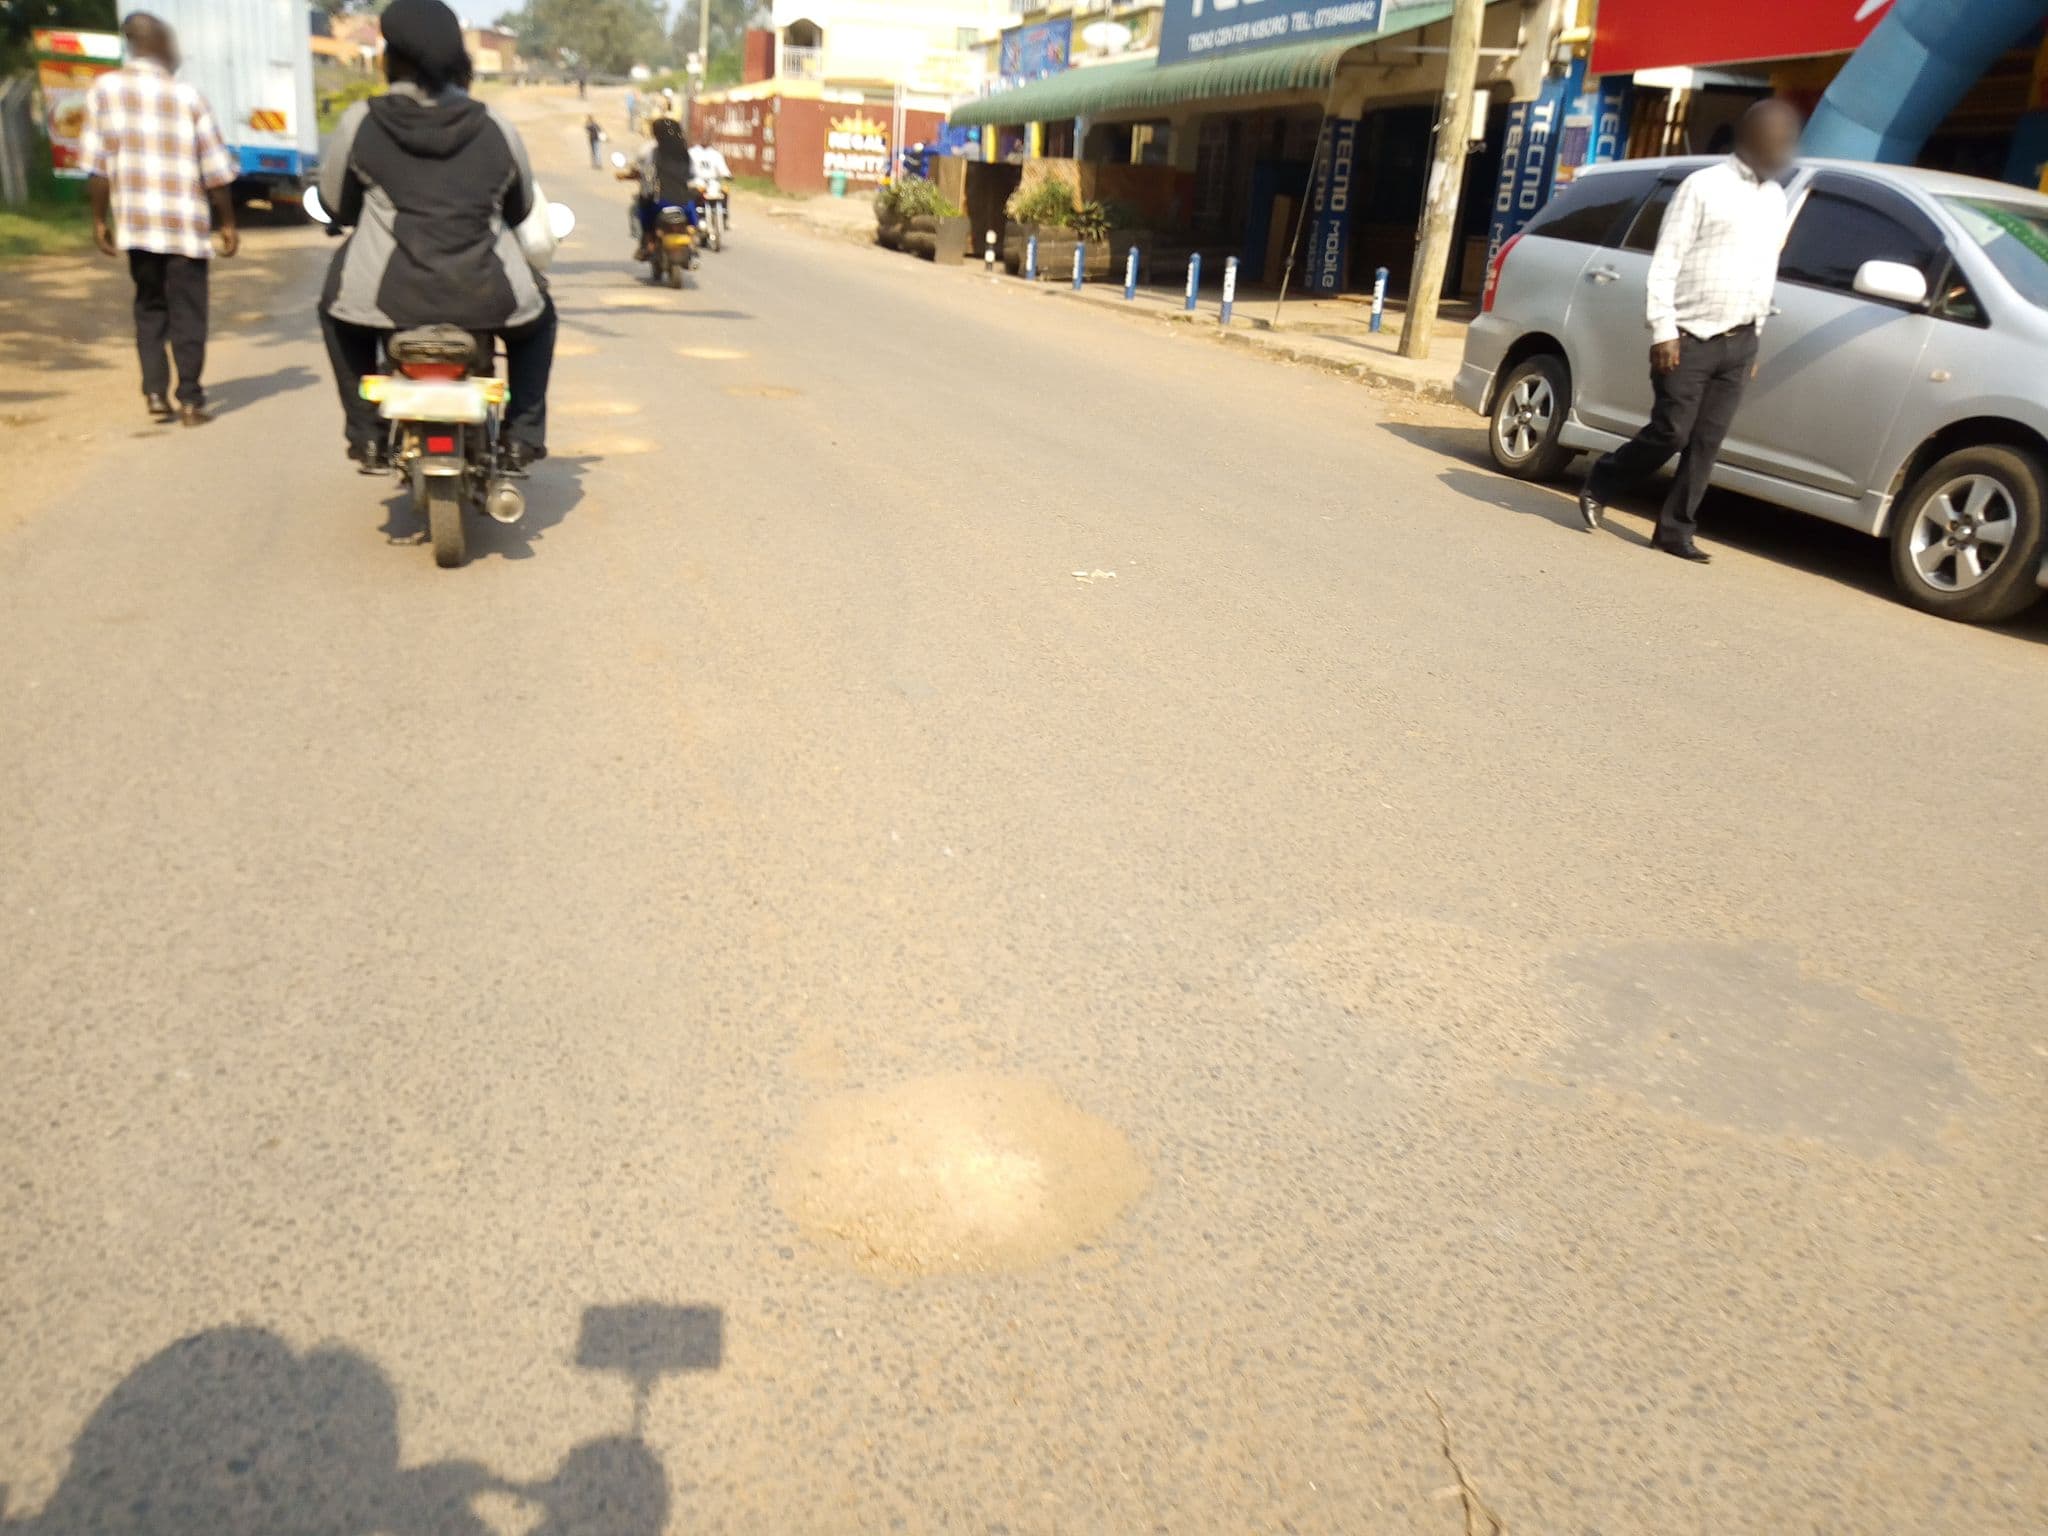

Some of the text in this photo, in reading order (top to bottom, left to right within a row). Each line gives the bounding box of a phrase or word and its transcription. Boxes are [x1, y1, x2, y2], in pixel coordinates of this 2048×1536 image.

[1214, 23, 1249, 47] CENTER
[1330, 122, 1356, 211] TECNO
[1496, 103, 1527, 212] TECNO
[1519, 100, 1555, 210] TECNO
[1595, 95, 1623, 163] TEC
